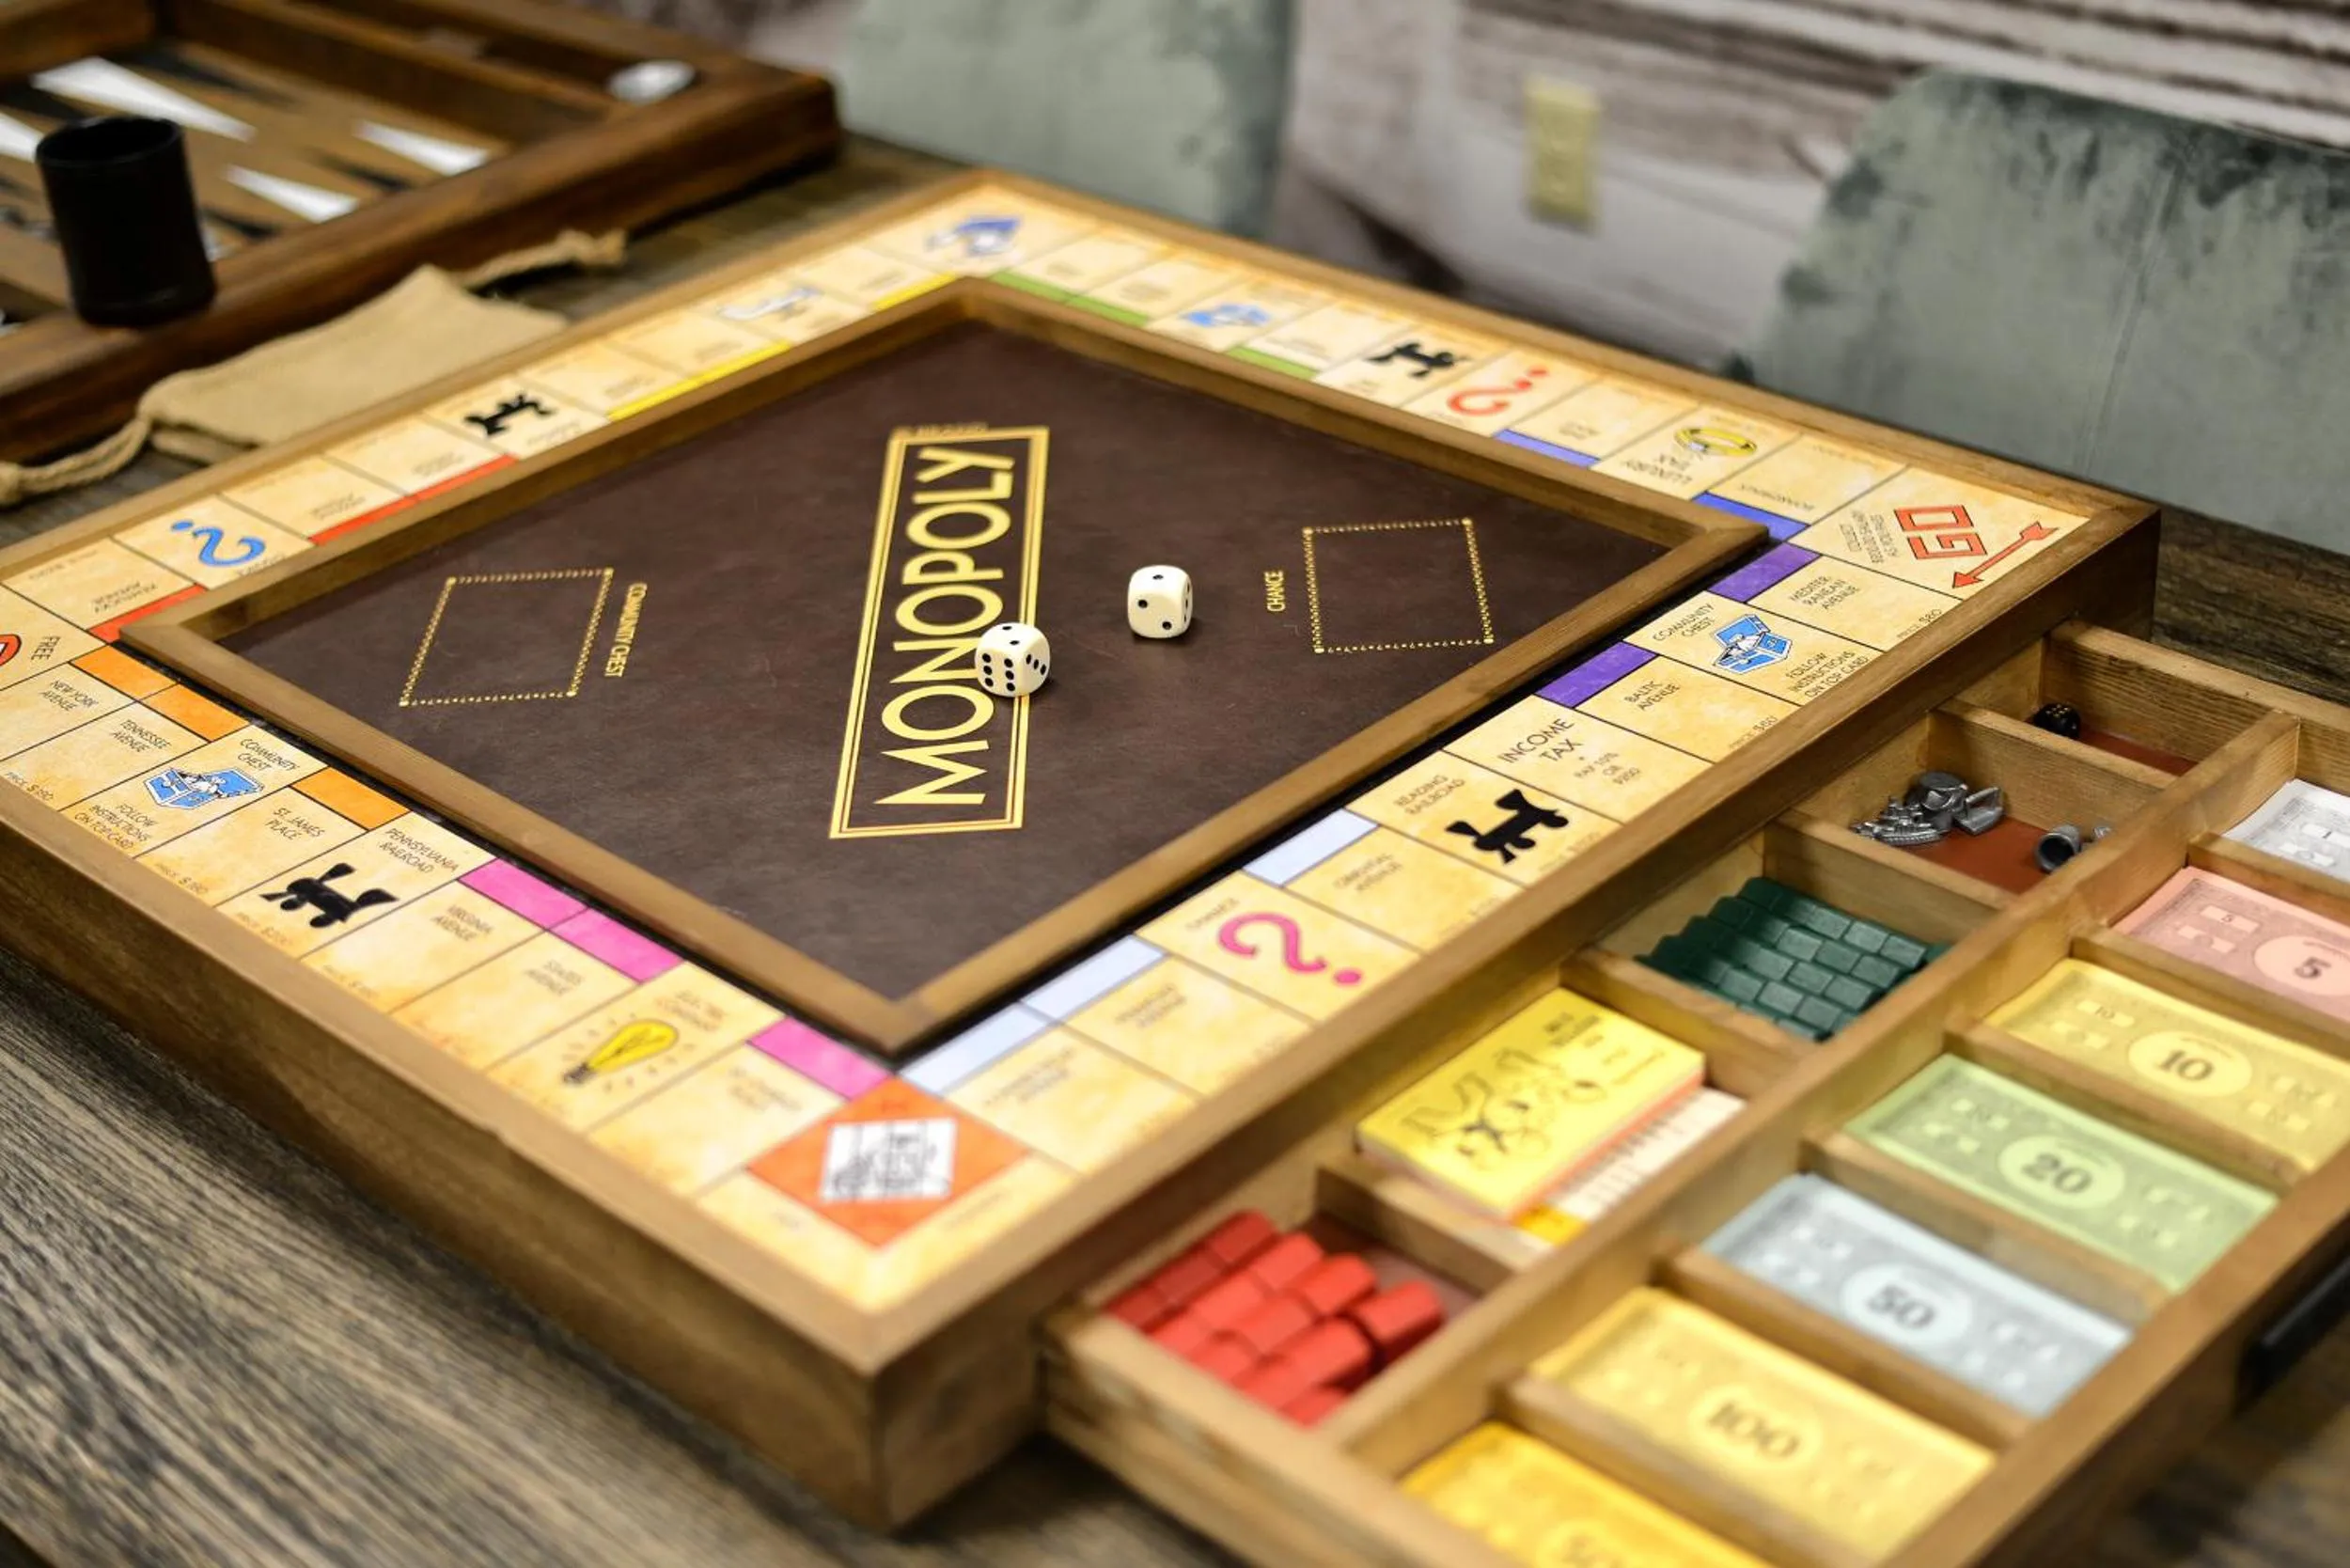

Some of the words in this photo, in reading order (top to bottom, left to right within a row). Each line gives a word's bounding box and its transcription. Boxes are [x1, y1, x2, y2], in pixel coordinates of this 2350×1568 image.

[1893, 504, 1988, 560] GO
[1263, 570, 1286, 612] CHANCE
[1821, 585, 1862, 611] AVENUE
[872, 447, 1015, 806] MONOPOLY
[1652, 603, 1716, 642] COMMUNITY
[1681, 616, 1716, 638] CHEST
[31, 635, 61, 660] FREE
[604, 645, 631, 677] CHEST
[1786, 651, 1828, 679] FOLLOW
[1790, 650, 1856, 692] INSTRUCTIONS
[1804, 685, 1825, 698] ON
[1824, 671, 1843, 688] TOP
[1841, 655, 1870, 675] CARD
[39, 690, 77, 712] AVENUE
[50, 679, 71, 698] NEW
[71, 689, 100, 709] YORK
[1624, 679, 1664, 703] BALTIC
[1637, 682, 1681, 712] AVENUE
[109, 729, 151, 753] AVENUE
[120, 718, 172, 750] TENNESSEE
[1496, 717, 1575, 764] INCOME
[1538, 738, 1584, 762] TAX
[237, 752, 273, 772] CHEST
[241, 738, 301, 772] COMMUNITY
[1392, 773, 1449, 808] READING
[1404, 777, 1466, 816] RAILROAD
[88, 804, 151, 842] INSTRUCTIONS
[116, 803, 158, 827] FOLLOW
[265, 819, 303, 841] PLACE
[291, 816, 325, 839] JAMES
[89, 820, 112, 837] TOP
[108, 830, 134, 850] CARD
[385, 827, 460, 873] PENNSYLVANIA
[378, 840, 435, 874] RAILROAD
[2294, 956, 2332, 979] 5
[2157, 1049, 2215, 1083] 10
[2021, 1152, 2093, 1195] 20
[1867, 1284, 1938, 1330] 50
[1707, 1401, 1801, 1460] 100
